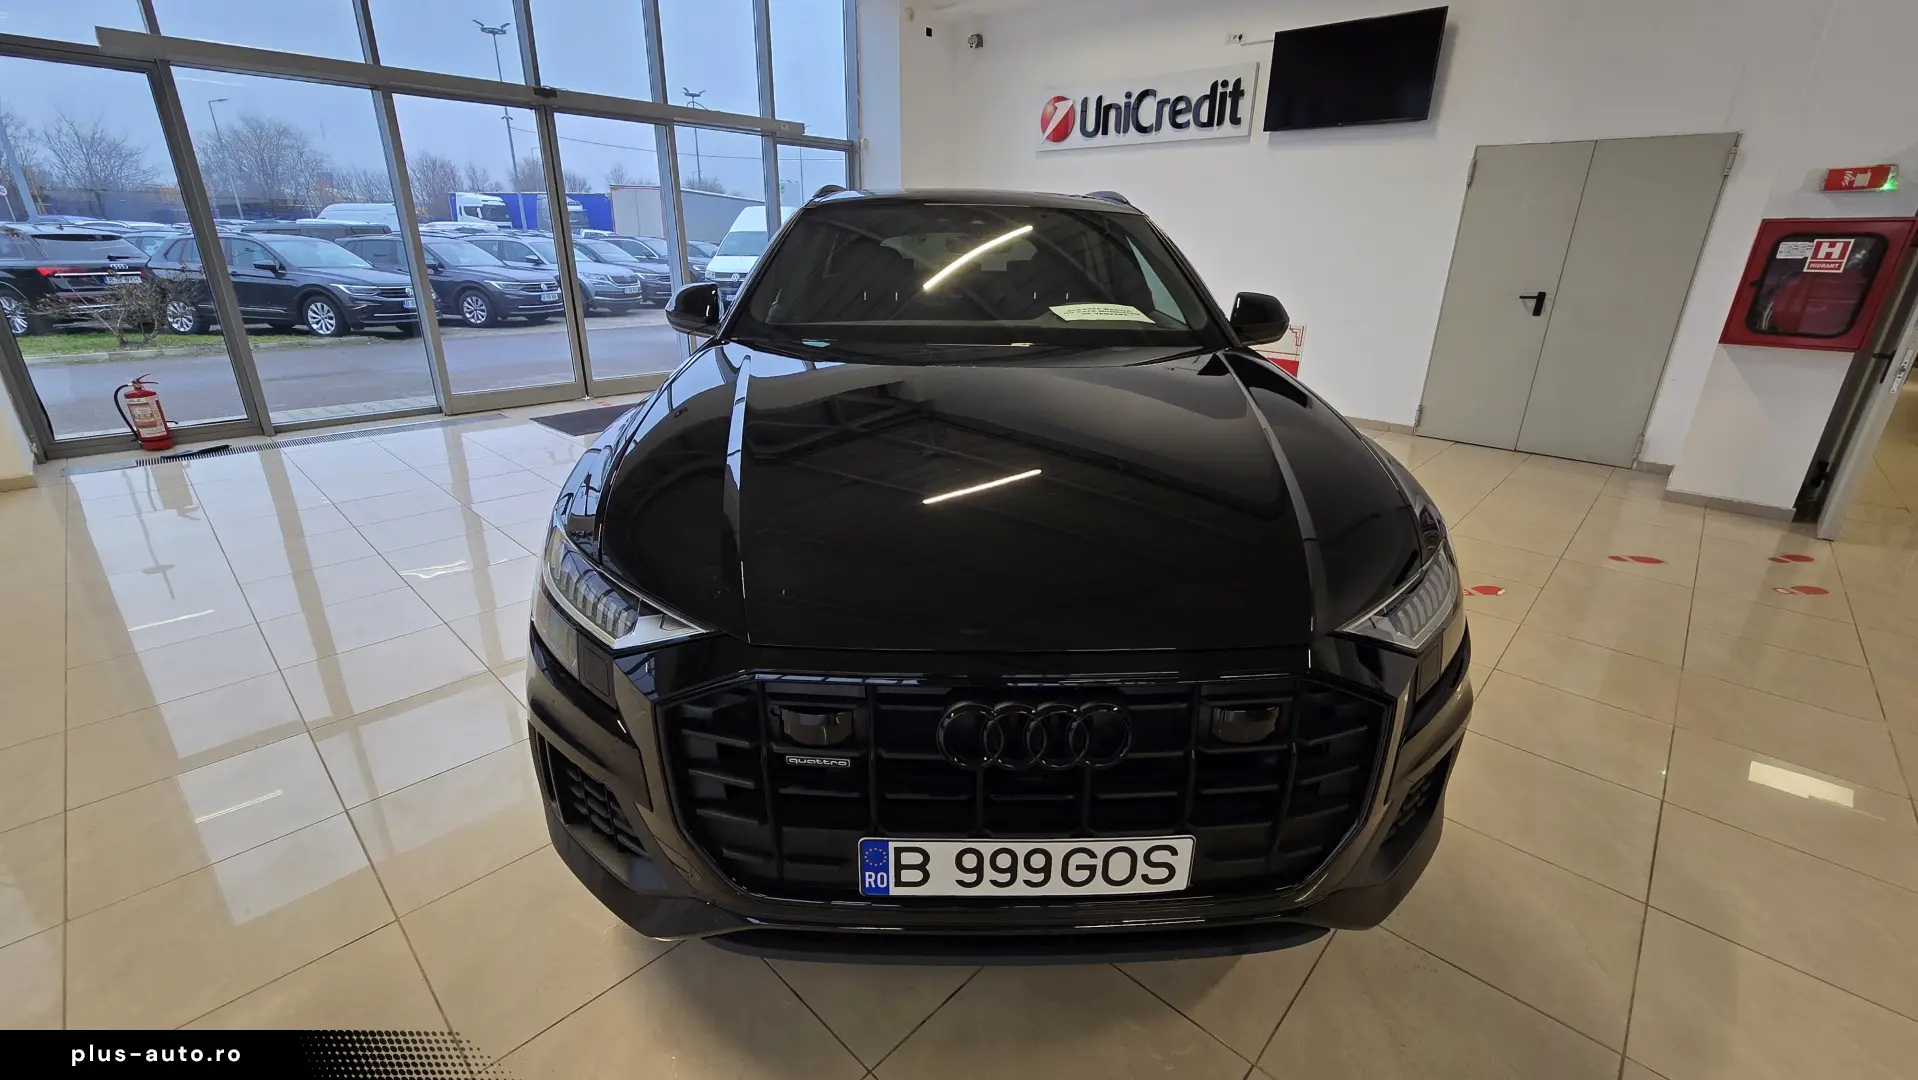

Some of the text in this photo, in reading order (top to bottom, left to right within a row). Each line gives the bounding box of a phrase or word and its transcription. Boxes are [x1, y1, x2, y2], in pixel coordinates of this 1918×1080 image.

[1080, 77, 1245, 139] UniCredit
[1817, 242, 1844, 259] H
[788, 758, 848, 766] quattro
[893, 846, 931, 888] B
[865, 871, 888, 889] RO
